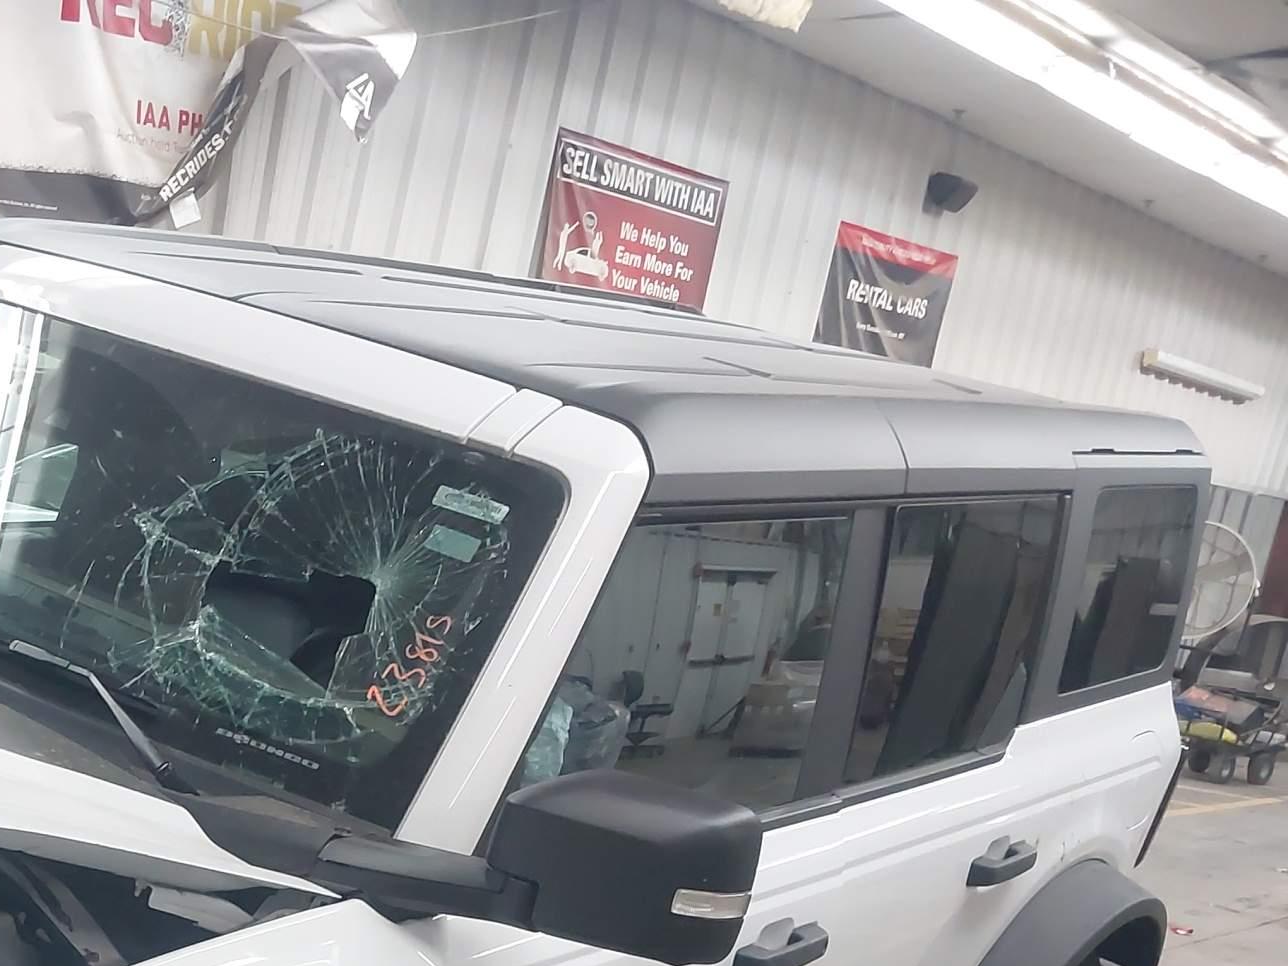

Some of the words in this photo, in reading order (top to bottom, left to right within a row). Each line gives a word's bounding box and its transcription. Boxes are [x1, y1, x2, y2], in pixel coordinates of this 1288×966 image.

[136, 100, 170, 131] IAA
[563, 147, 598, 182] SELL
[600, 158, 654, 198] SMART
[654, 175, 691, 211] WITH
[690, 187, 716, 218] IAA
[620, 221, 638, 242] We
[640, 227, 666, 253] Help
[669, 235, 689, 256] You
[615, 246, 642, 268] Earn
[643, 253, 672, 276] More
[675, 262, 693, 282] For
[612, 269, 638, 291] Your
[640, 276, 680, 302] Vehicle
[847, 278, 893, 311] RENTAL
[896, 293, 928, 319] CARS
